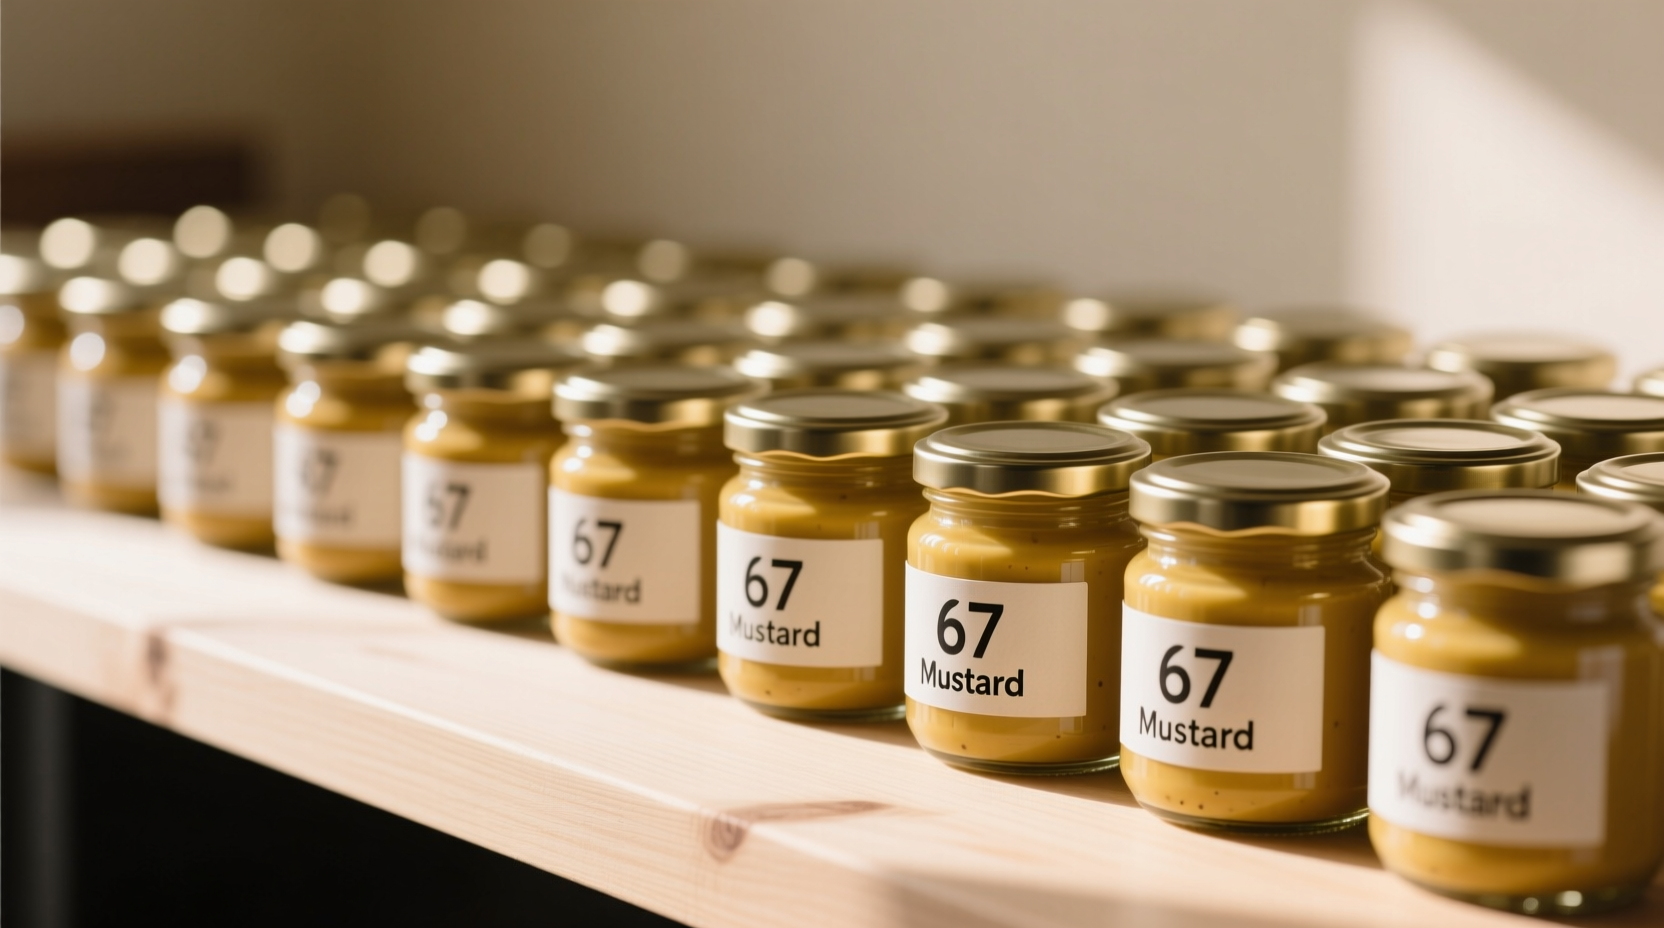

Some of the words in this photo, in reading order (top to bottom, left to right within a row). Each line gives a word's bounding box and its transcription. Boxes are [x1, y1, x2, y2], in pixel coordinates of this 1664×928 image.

[572, 517, 624, 568] 67
[744, 556, 803, 611] 67
[729, 610, 820, 647] Mustard
[936, 598, 1004, 659] 67
[921, 657, 1024, 697] Mustard
[1158, 644, 1233, 708] 67
[1139, 706, 1254, 751] Mustard
[1421, 704, 1507, 775] 67
[1397, 770, 1532, 822] Mustard
